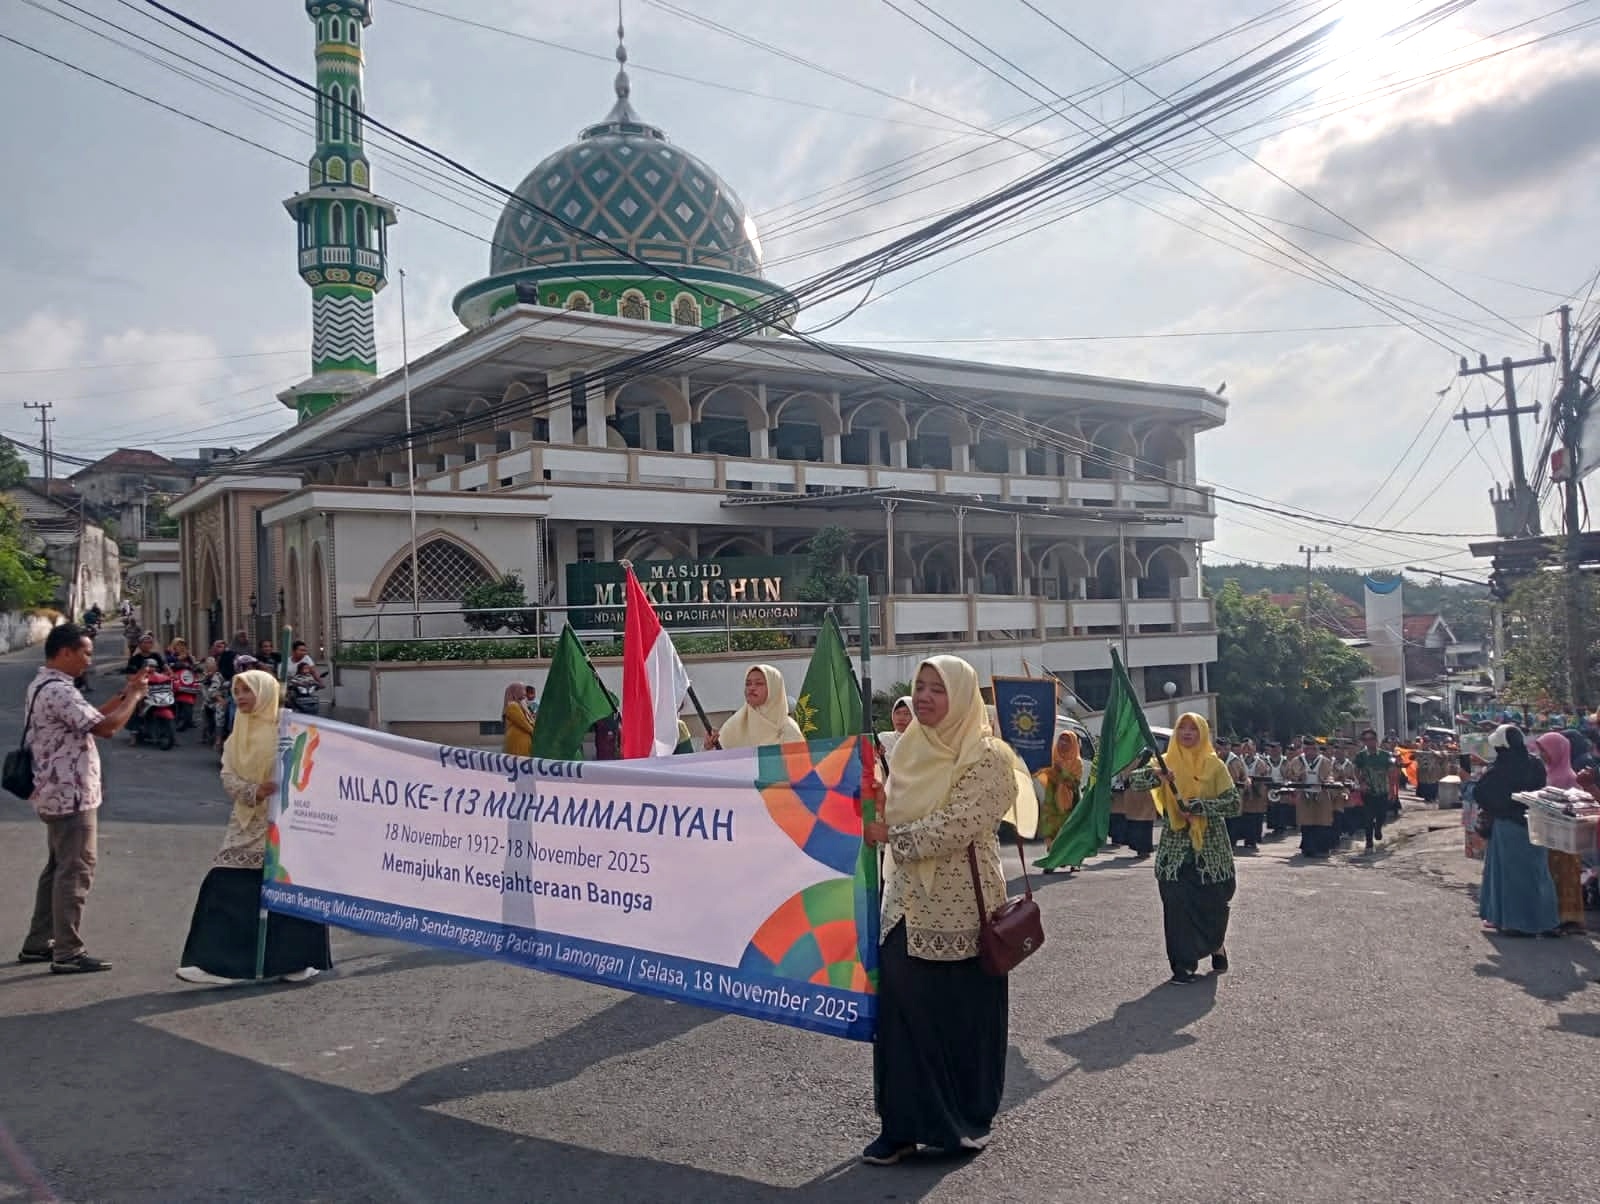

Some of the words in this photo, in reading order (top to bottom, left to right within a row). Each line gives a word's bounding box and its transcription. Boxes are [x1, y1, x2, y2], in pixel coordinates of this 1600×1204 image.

[651, 564, 722, 579] MASJID
[676, 609, 725, 621] PACIRAN
[338, 775, 399, 806] MILAD
[405, 782, 481, 815] KE-113
[483, 790, 734, 842] MUHAMMADIYAH
[385, 823, 399, 841] 18
[400, 824, 463, 849] November
[527, 840, 603, 869] November
[607, 850, 651, 875] 2025
[382, 852, 461, 883] Memajukan
[465, 864, 582, 901] Kesejahteraan
[587, 881, 653, 914] Bangsa
[297, 892, 331, 918] Ranting
[333, 900, 419, 931] Muhammadiyah
[421, 916, 504, 951] Sendangagung
[506, 933, 553, 960] Paciran
[555, 943, 624, 976] Lamongan
[638, 959, 688, 991] Selasa,
[693, 971, 713, 992] 18
[719, 975, 811, 1013] November
[813, 995, 859, 1023] 2025
